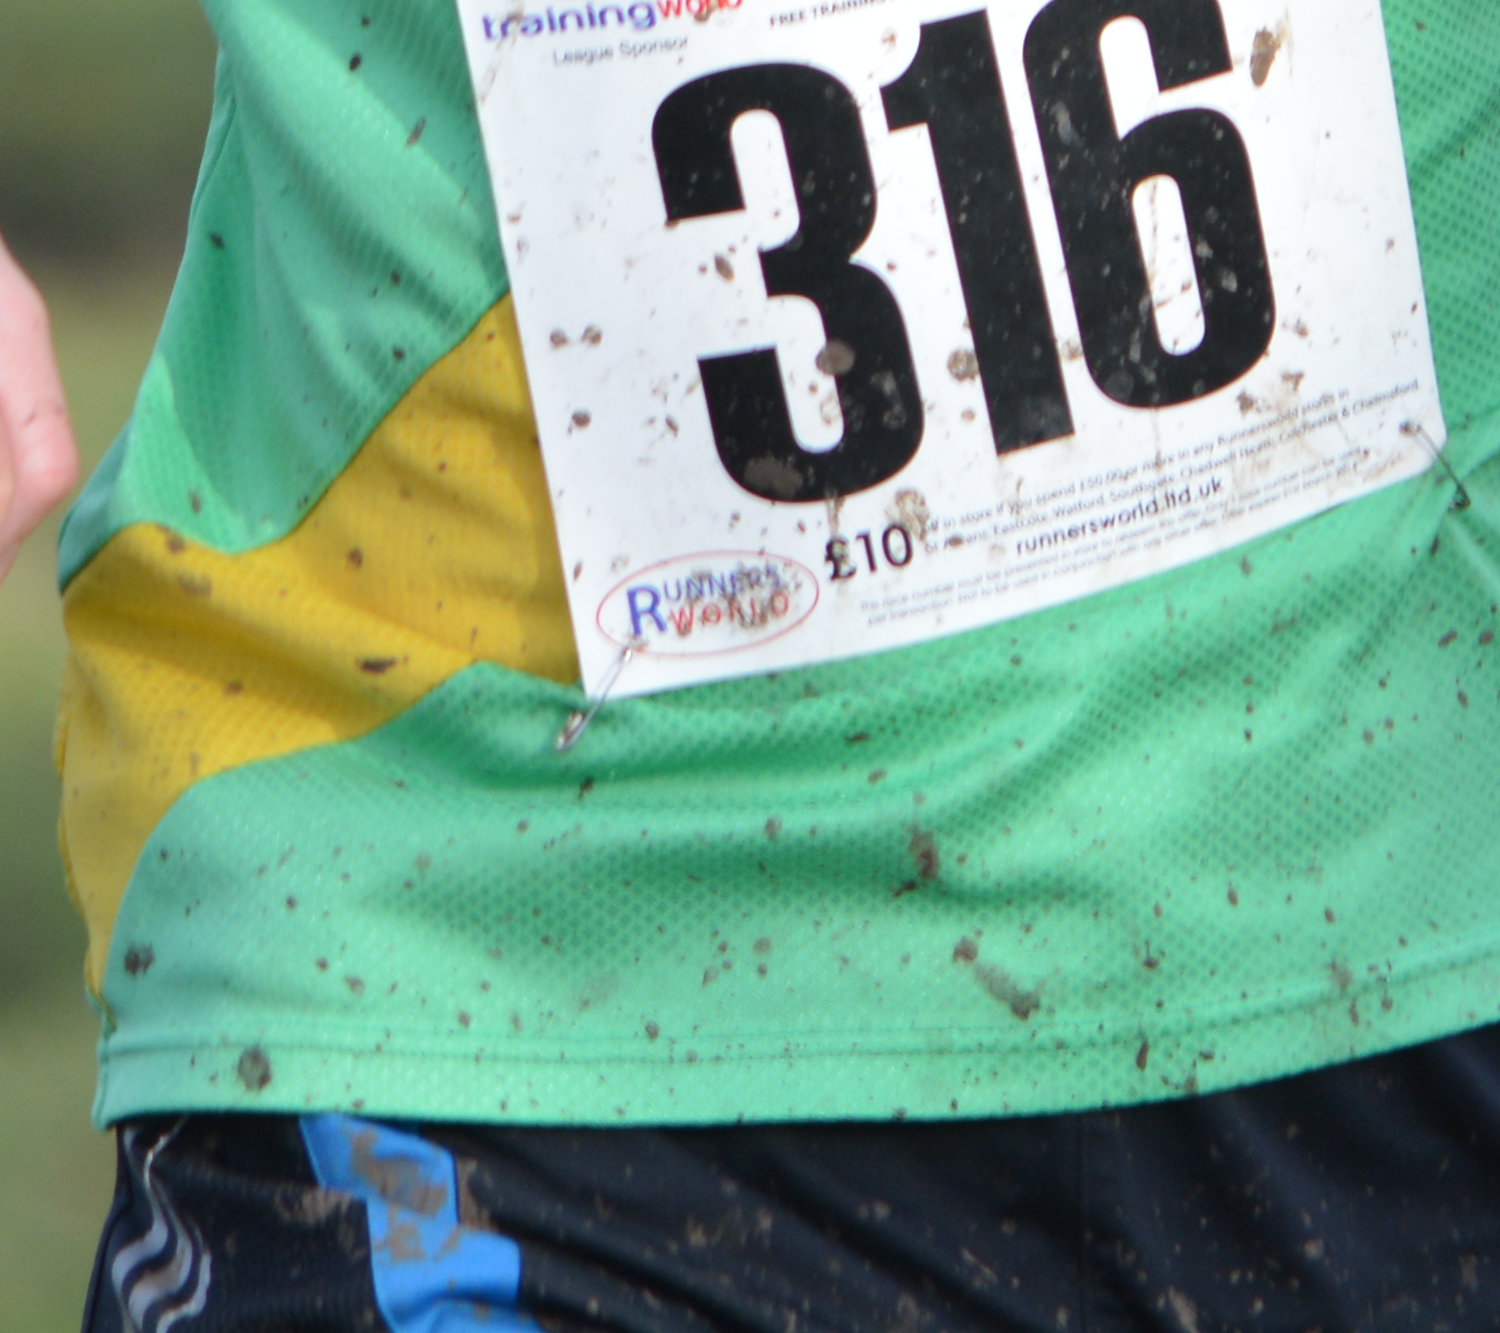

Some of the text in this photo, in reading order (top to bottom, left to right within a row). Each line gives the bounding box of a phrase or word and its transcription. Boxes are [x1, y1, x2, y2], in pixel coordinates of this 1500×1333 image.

[769, 10, 805, 28] FREE
[553, 36, 688, 67] League Sponsor
[824, 522, 915, 582] £10
[1035, 483, 1075, 503] spend
[1016, 475, 1224, 556] runnersworld.ltd.uk
